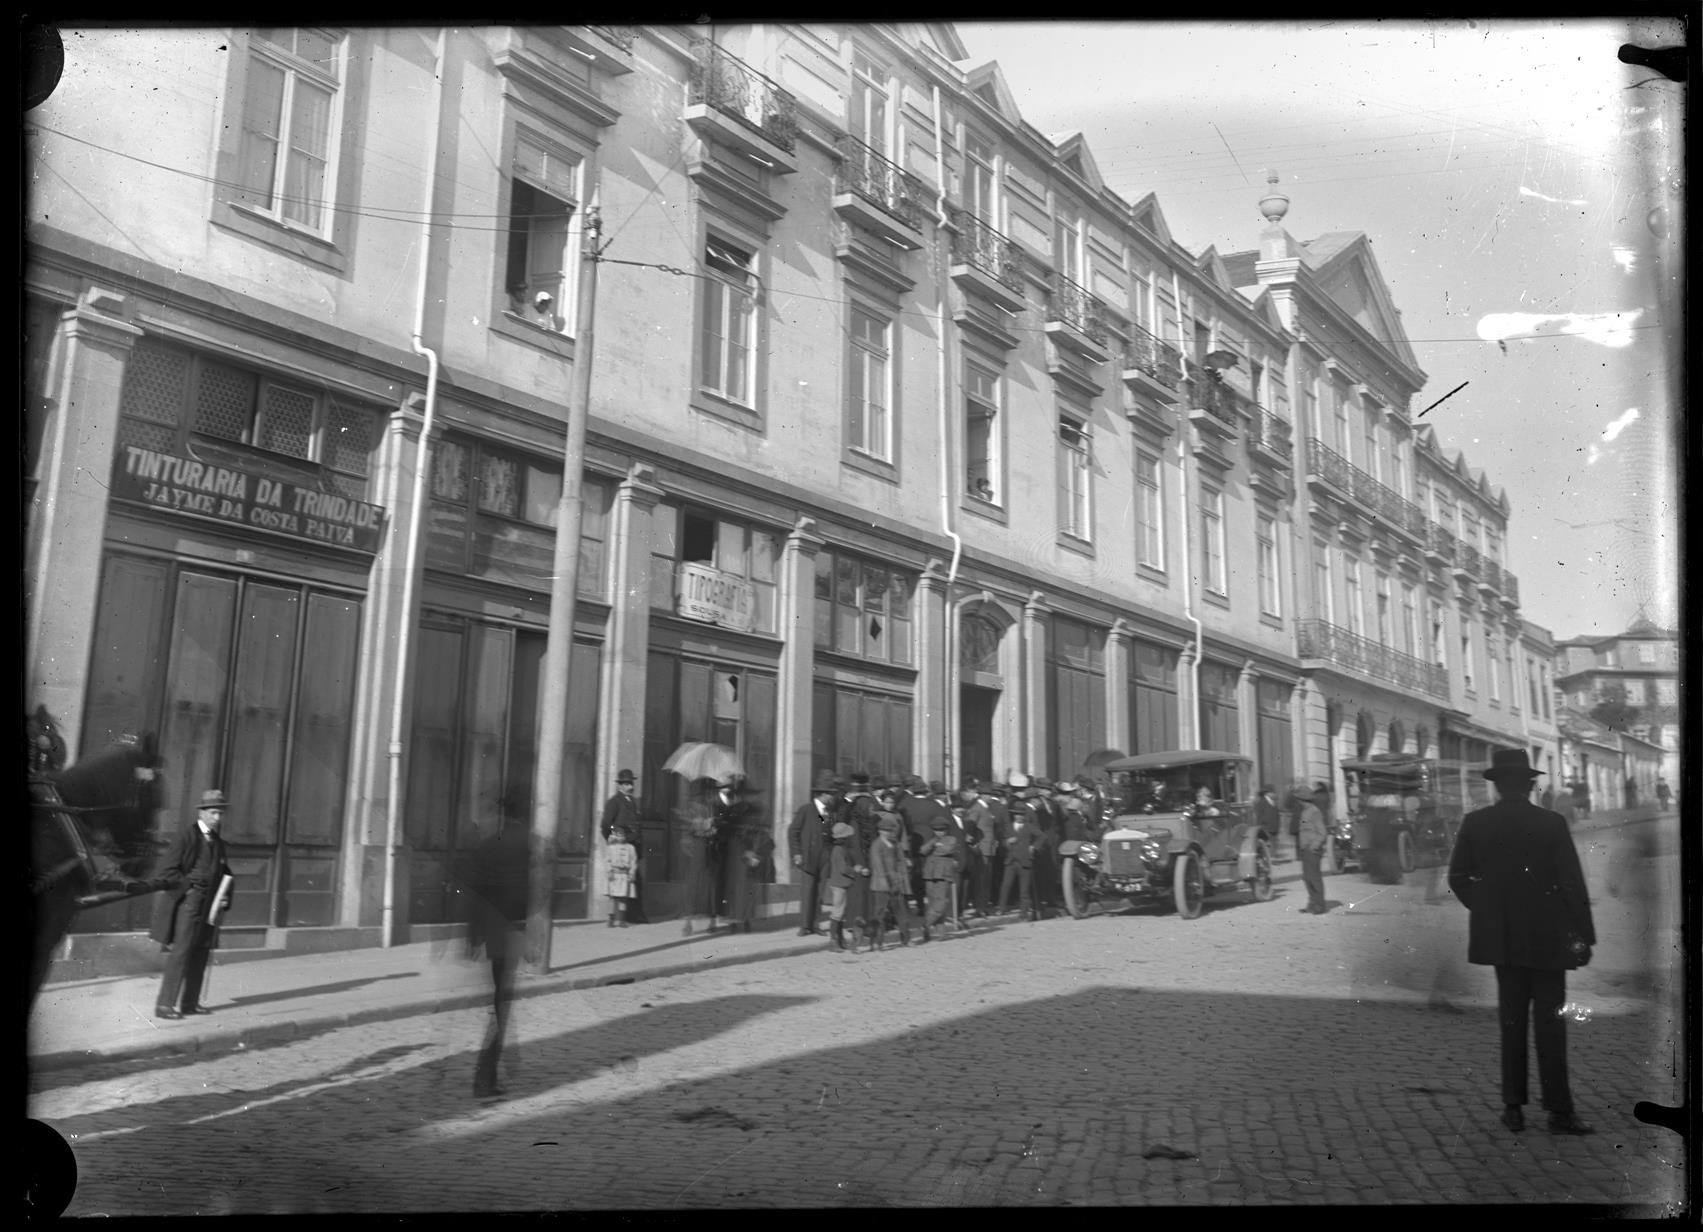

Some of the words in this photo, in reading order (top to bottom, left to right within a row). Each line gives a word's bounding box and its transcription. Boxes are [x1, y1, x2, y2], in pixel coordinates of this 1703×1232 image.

[126, 446, 247, 499] TINTURARIA
[256, 478, 283, 507] DA
[294, 487, 385, 530] TRINDADE
[143, 483, 213, 513] JAYME
[220, 501, 244, 520] DA
[250, 507, 299, 532] COSTA
[306, 518, 355, 545] PAIVA
